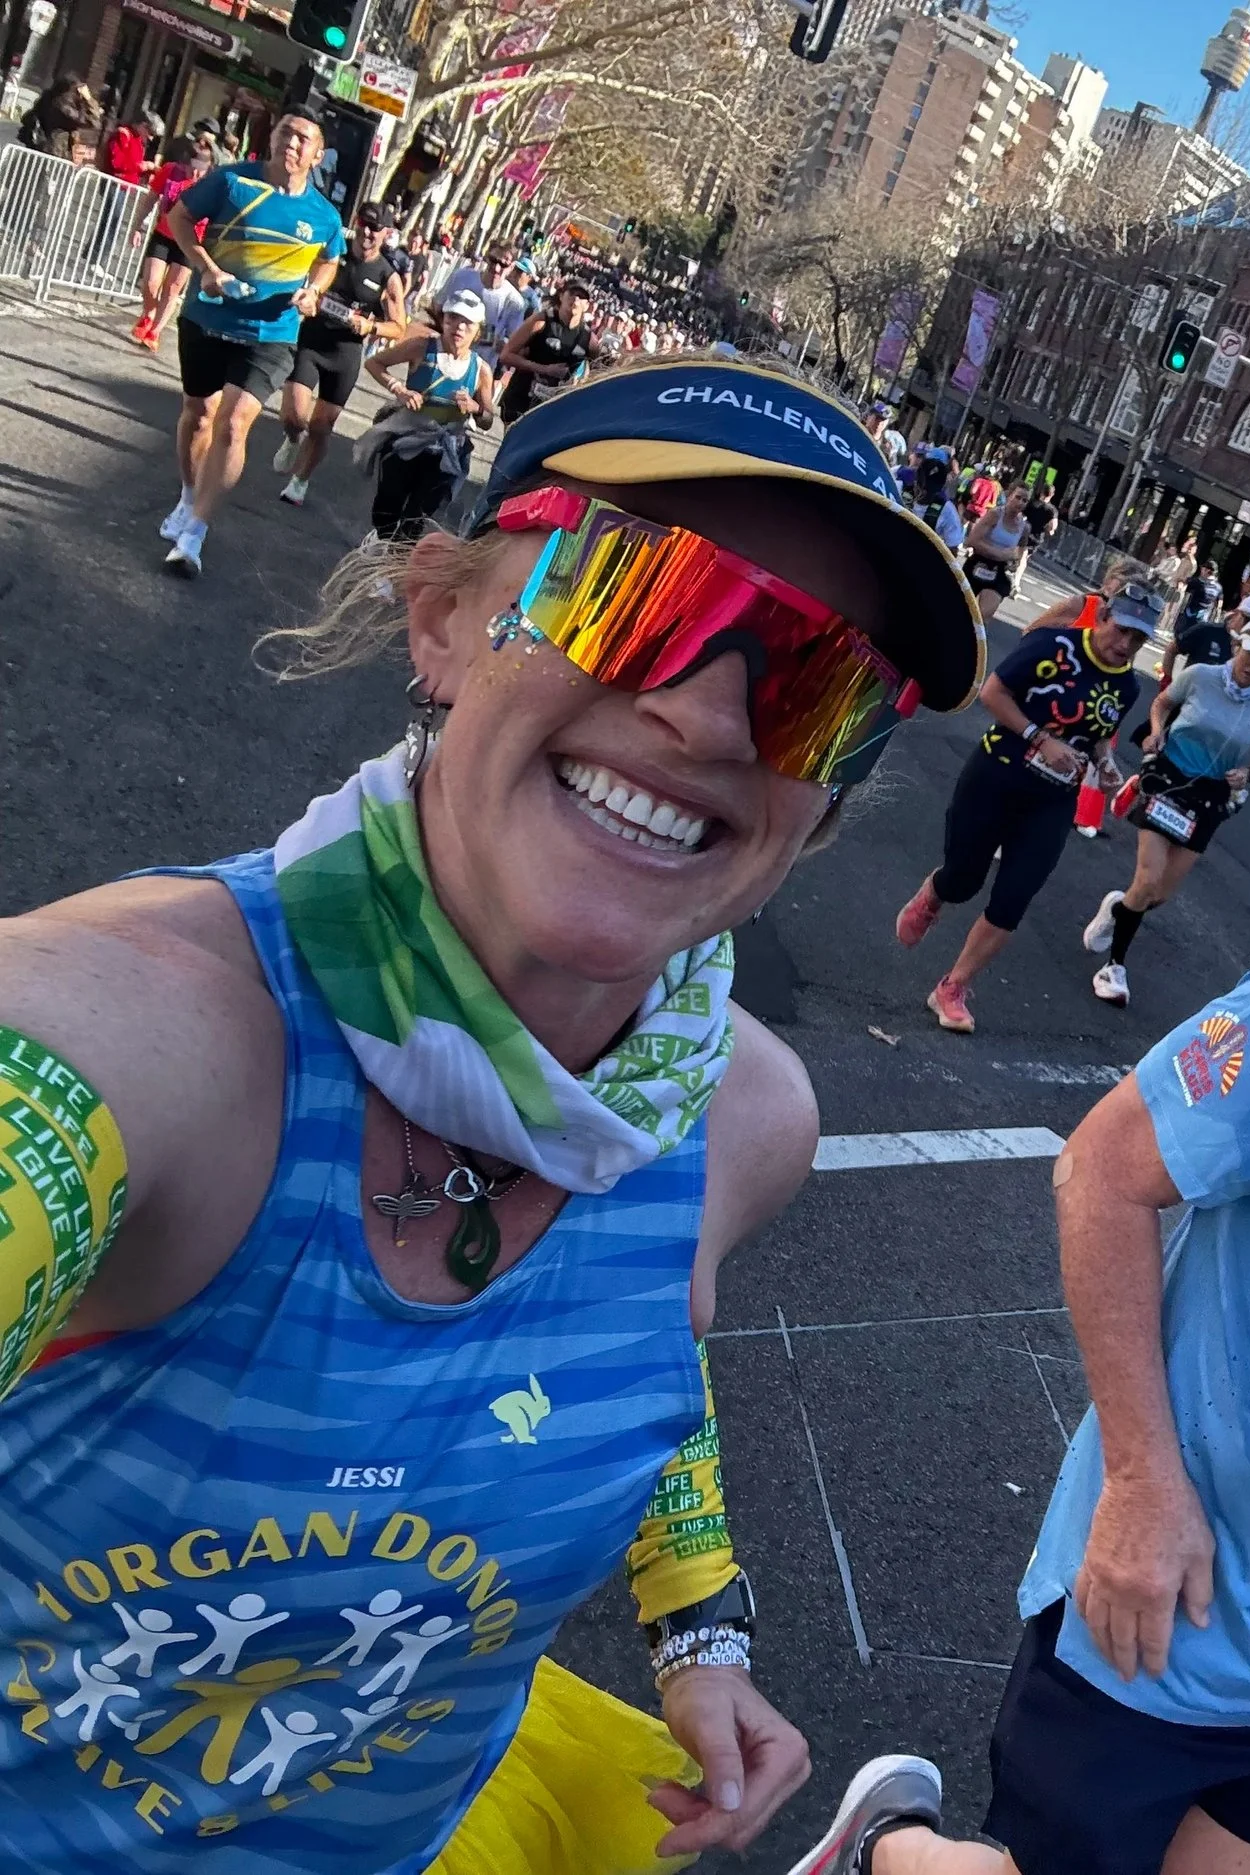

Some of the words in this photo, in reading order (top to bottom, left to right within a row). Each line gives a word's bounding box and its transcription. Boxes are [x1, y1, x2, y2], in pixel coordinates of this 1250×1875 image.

[657, 387, 867, 475] CHALLENGE
[10, 1039, 93, 1115] LIFE
[10, 1106, 83, 1196] LIVE
[15, 1146, 72, 1241] GIVE
[327, 1466, 406, 1488] JESSI
[654, 1473, 690, 1495] LIFE
[668, 1491, 701, 1513] LIFE
[679, 1533, 717, 1556] GIVE
[62, 1509, 360, 1606] ORGAN
[370, 1511, 519, 1660] DONOR
